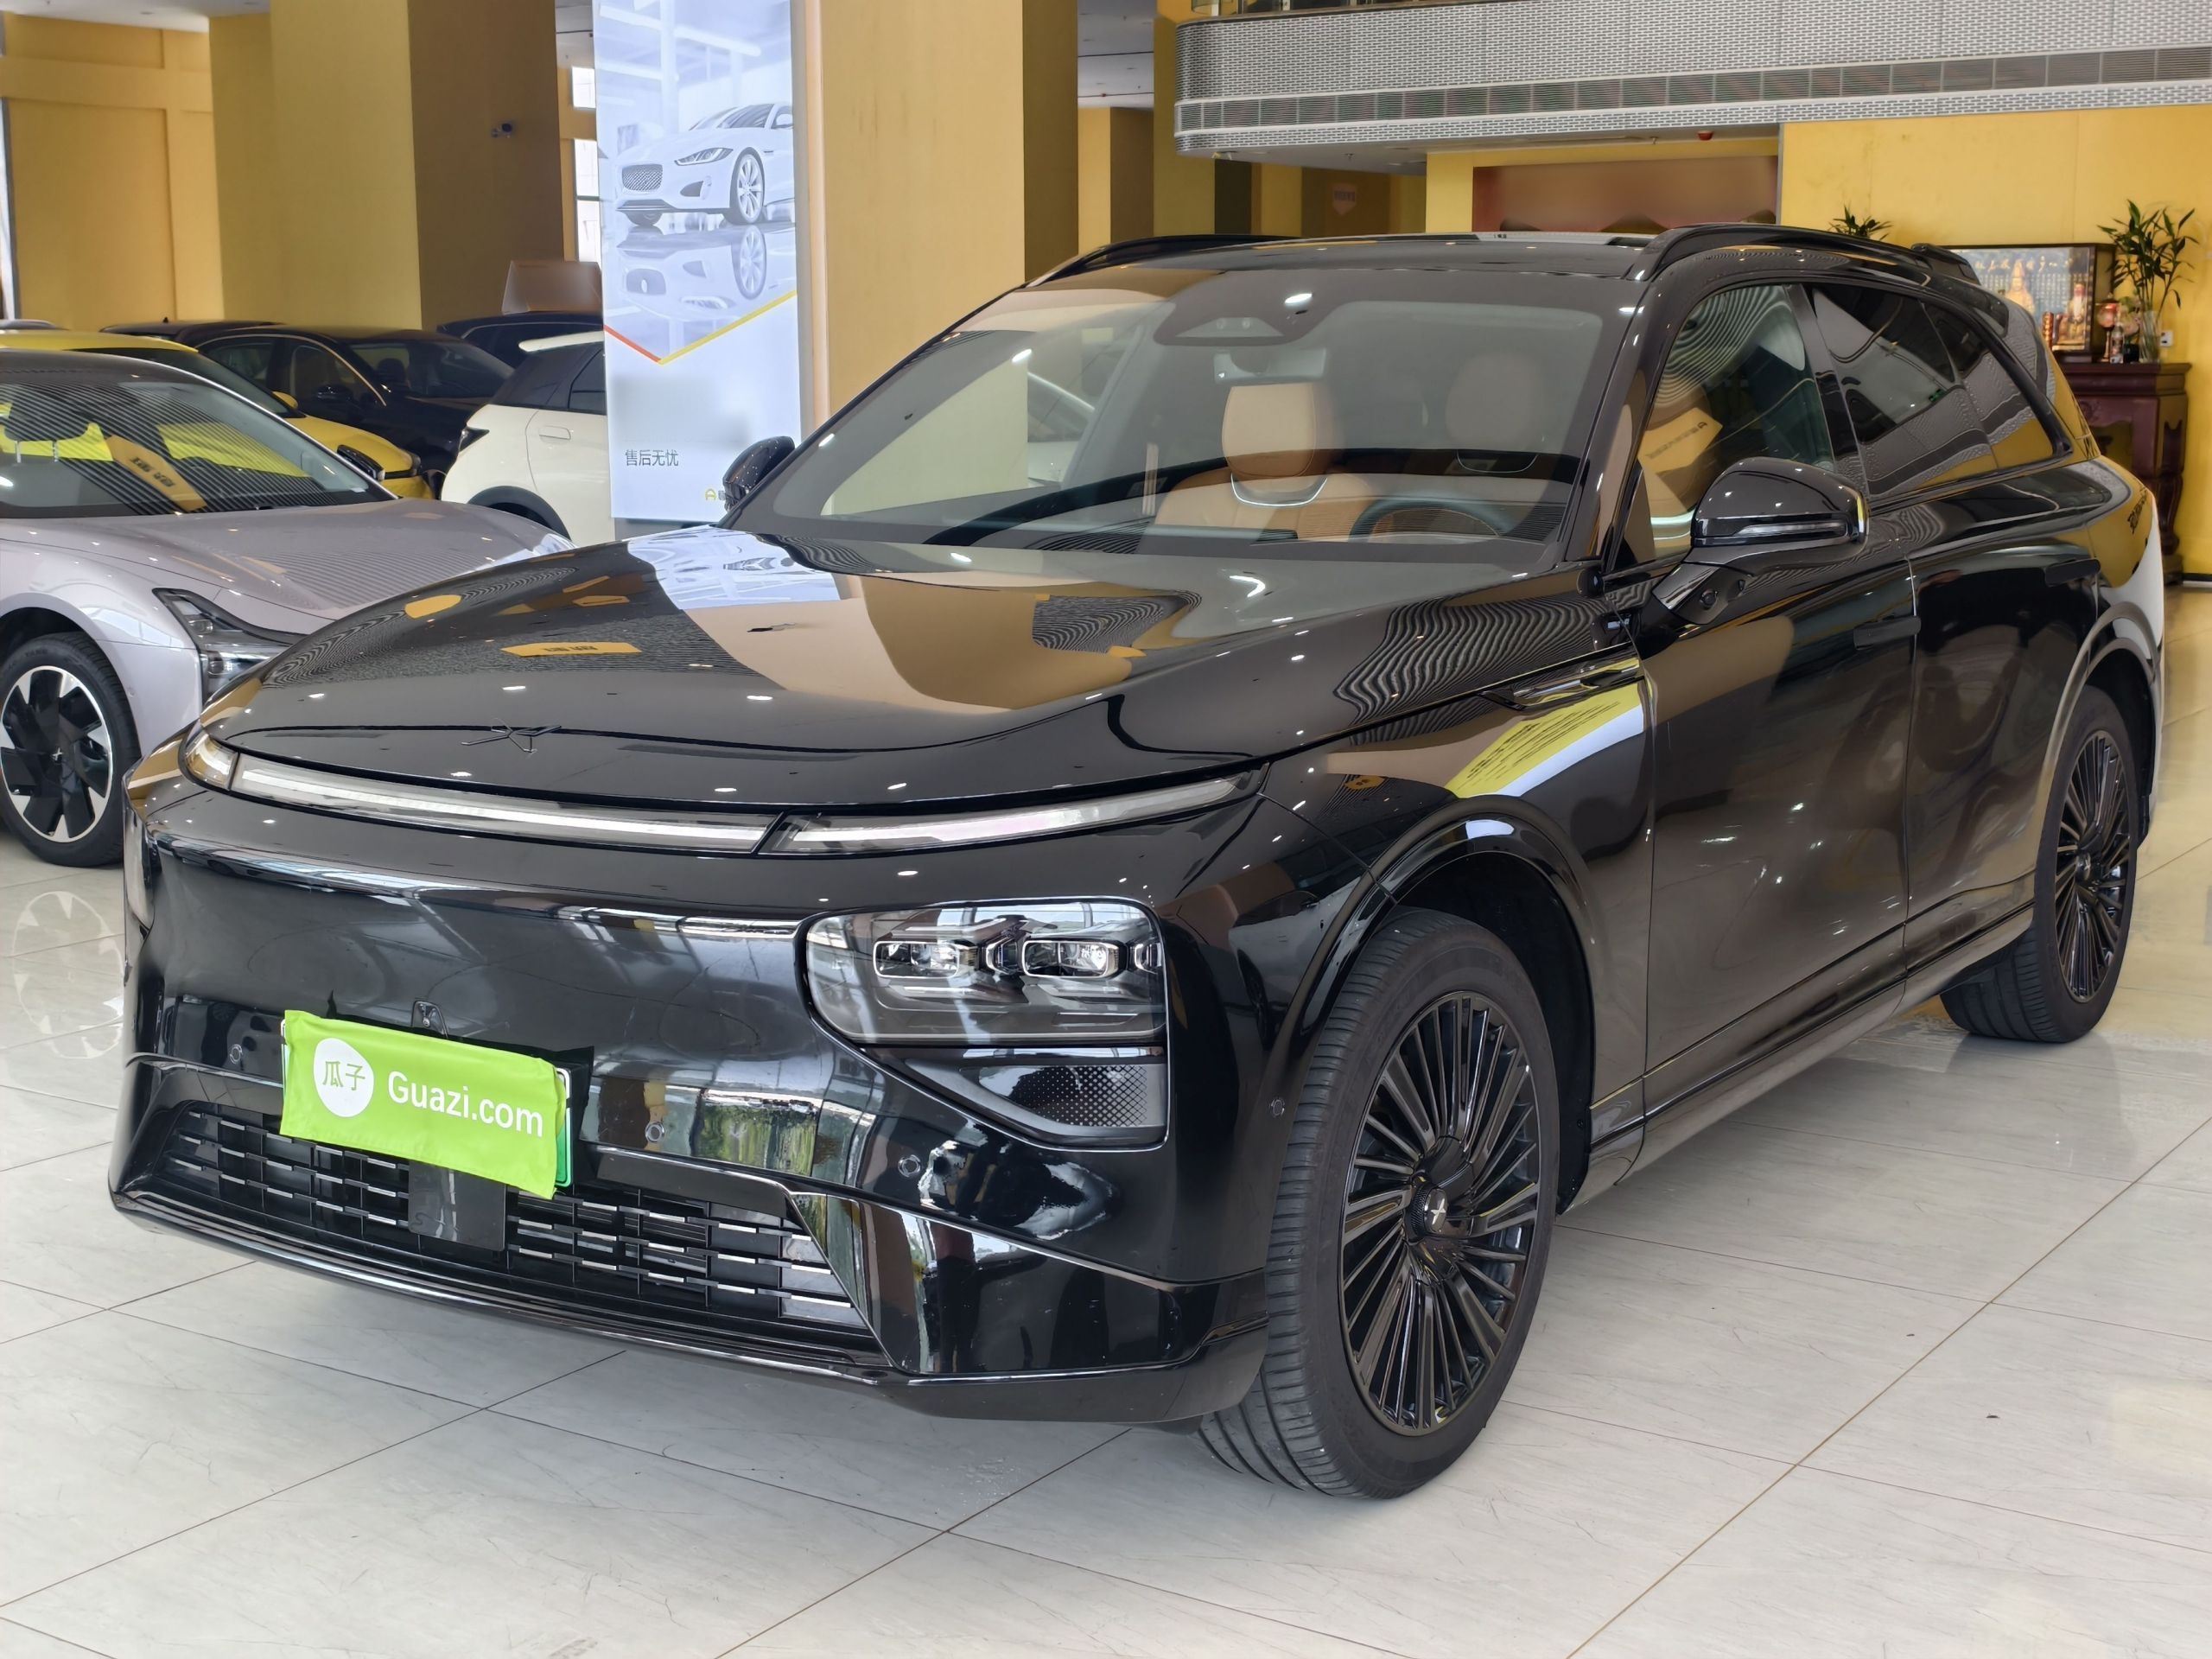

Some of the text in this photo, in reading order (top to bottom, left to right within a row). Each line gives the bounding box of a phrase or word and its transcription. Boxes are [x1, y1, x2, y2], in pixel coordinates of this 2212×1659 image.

[625, 448, 679, 467] 售后无忧
[322, 1060, 365, 1090] 瓜子
[388, 1071, 543, 1137] Guazi.com
